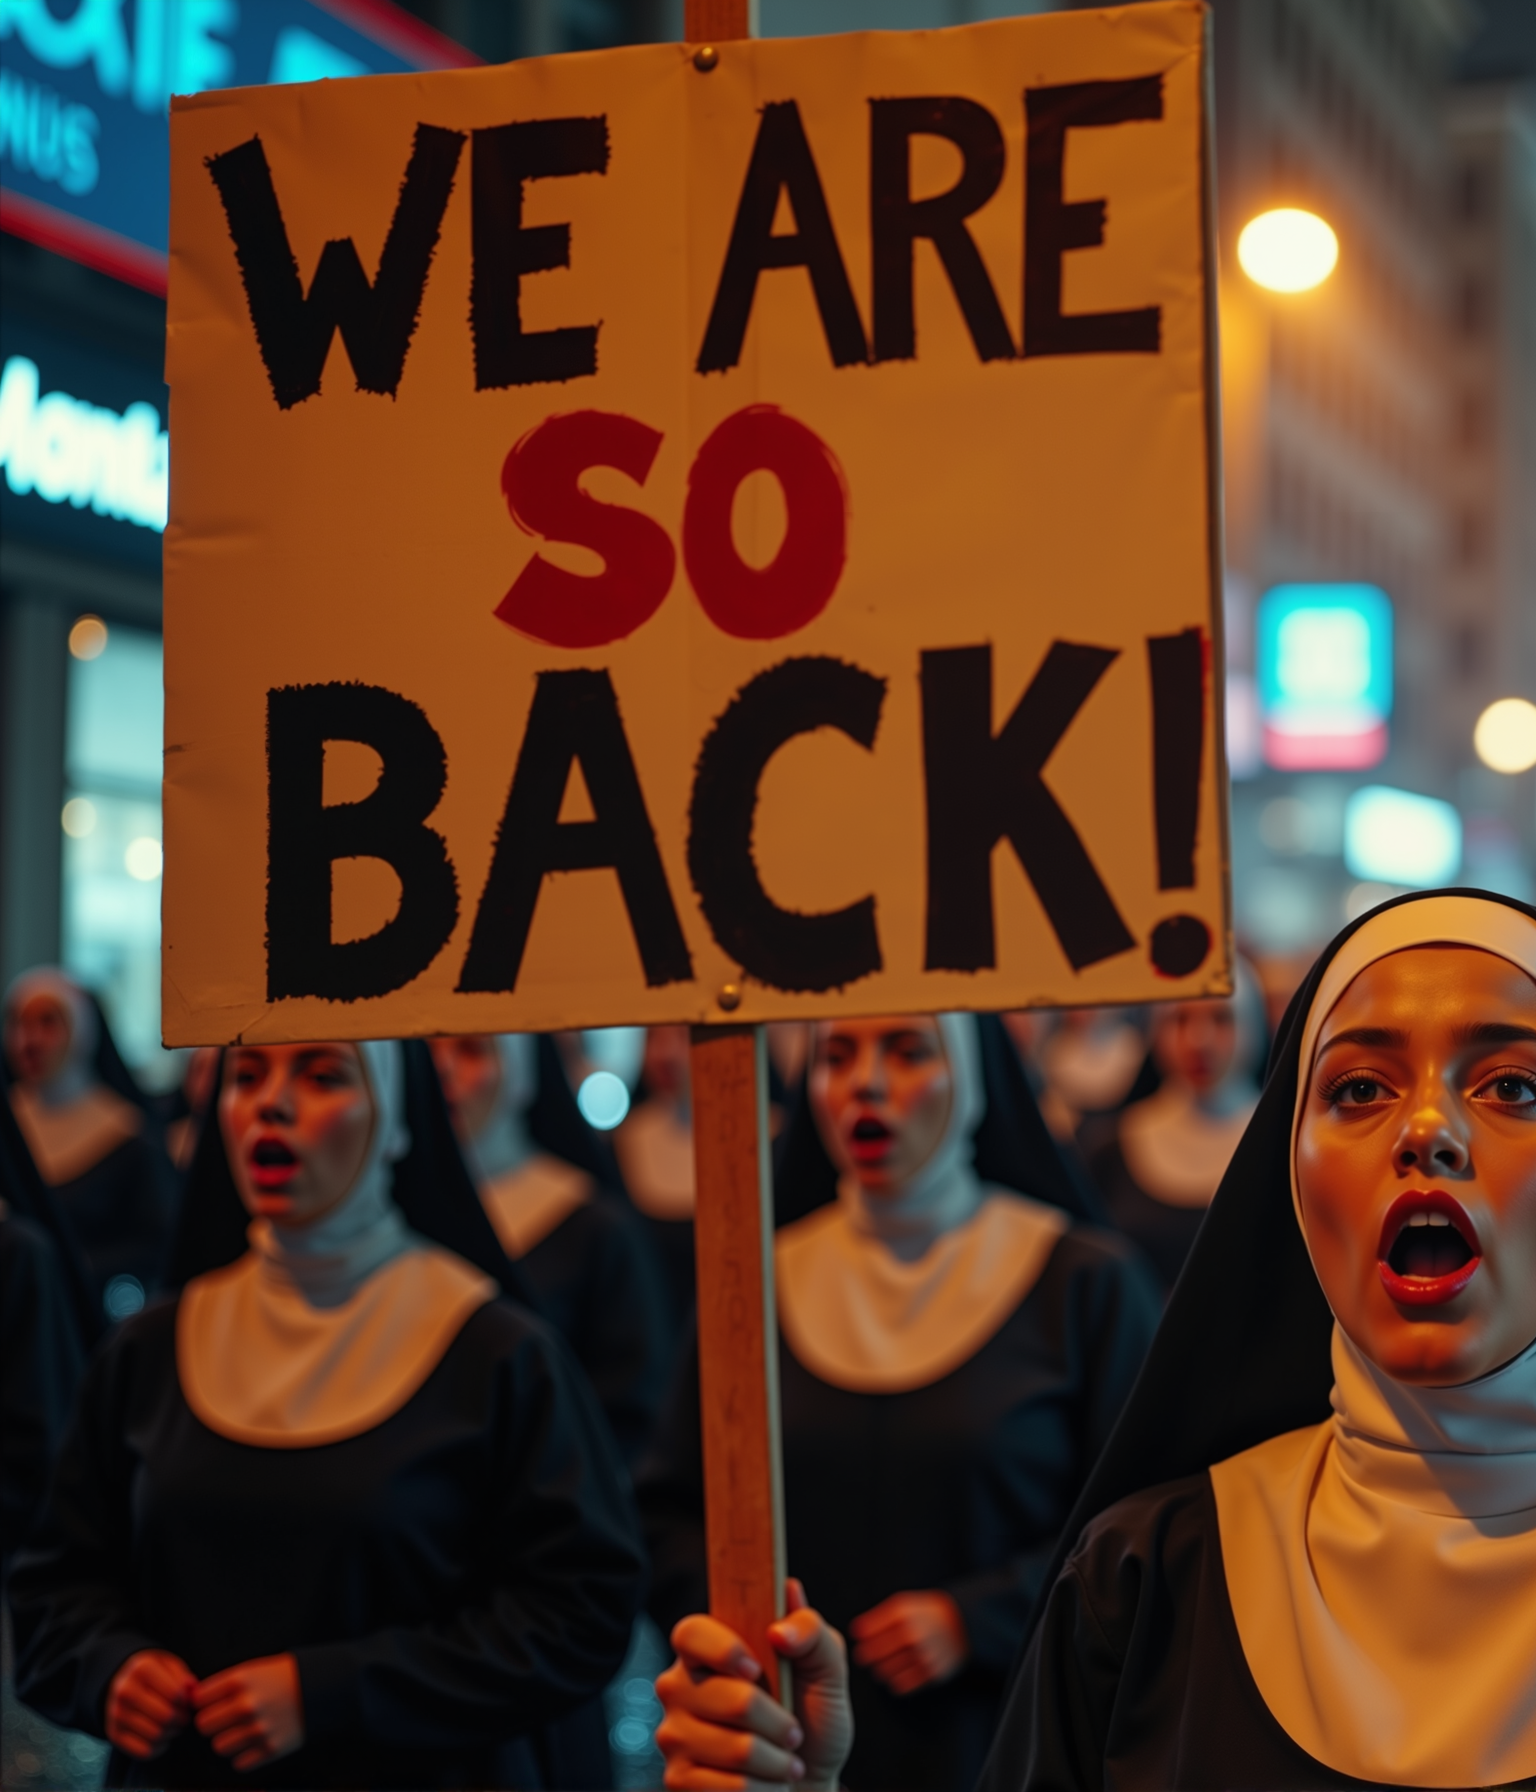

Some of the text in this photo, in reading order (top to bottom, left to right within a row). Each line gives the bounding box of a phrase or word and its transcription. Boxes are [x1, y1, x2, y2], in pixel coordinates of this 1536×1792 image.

[203, 73, 1165, 411] WE ARE
[493, 402, 851, 649] SO
[263, 625, 1213, 1004] BACK!
